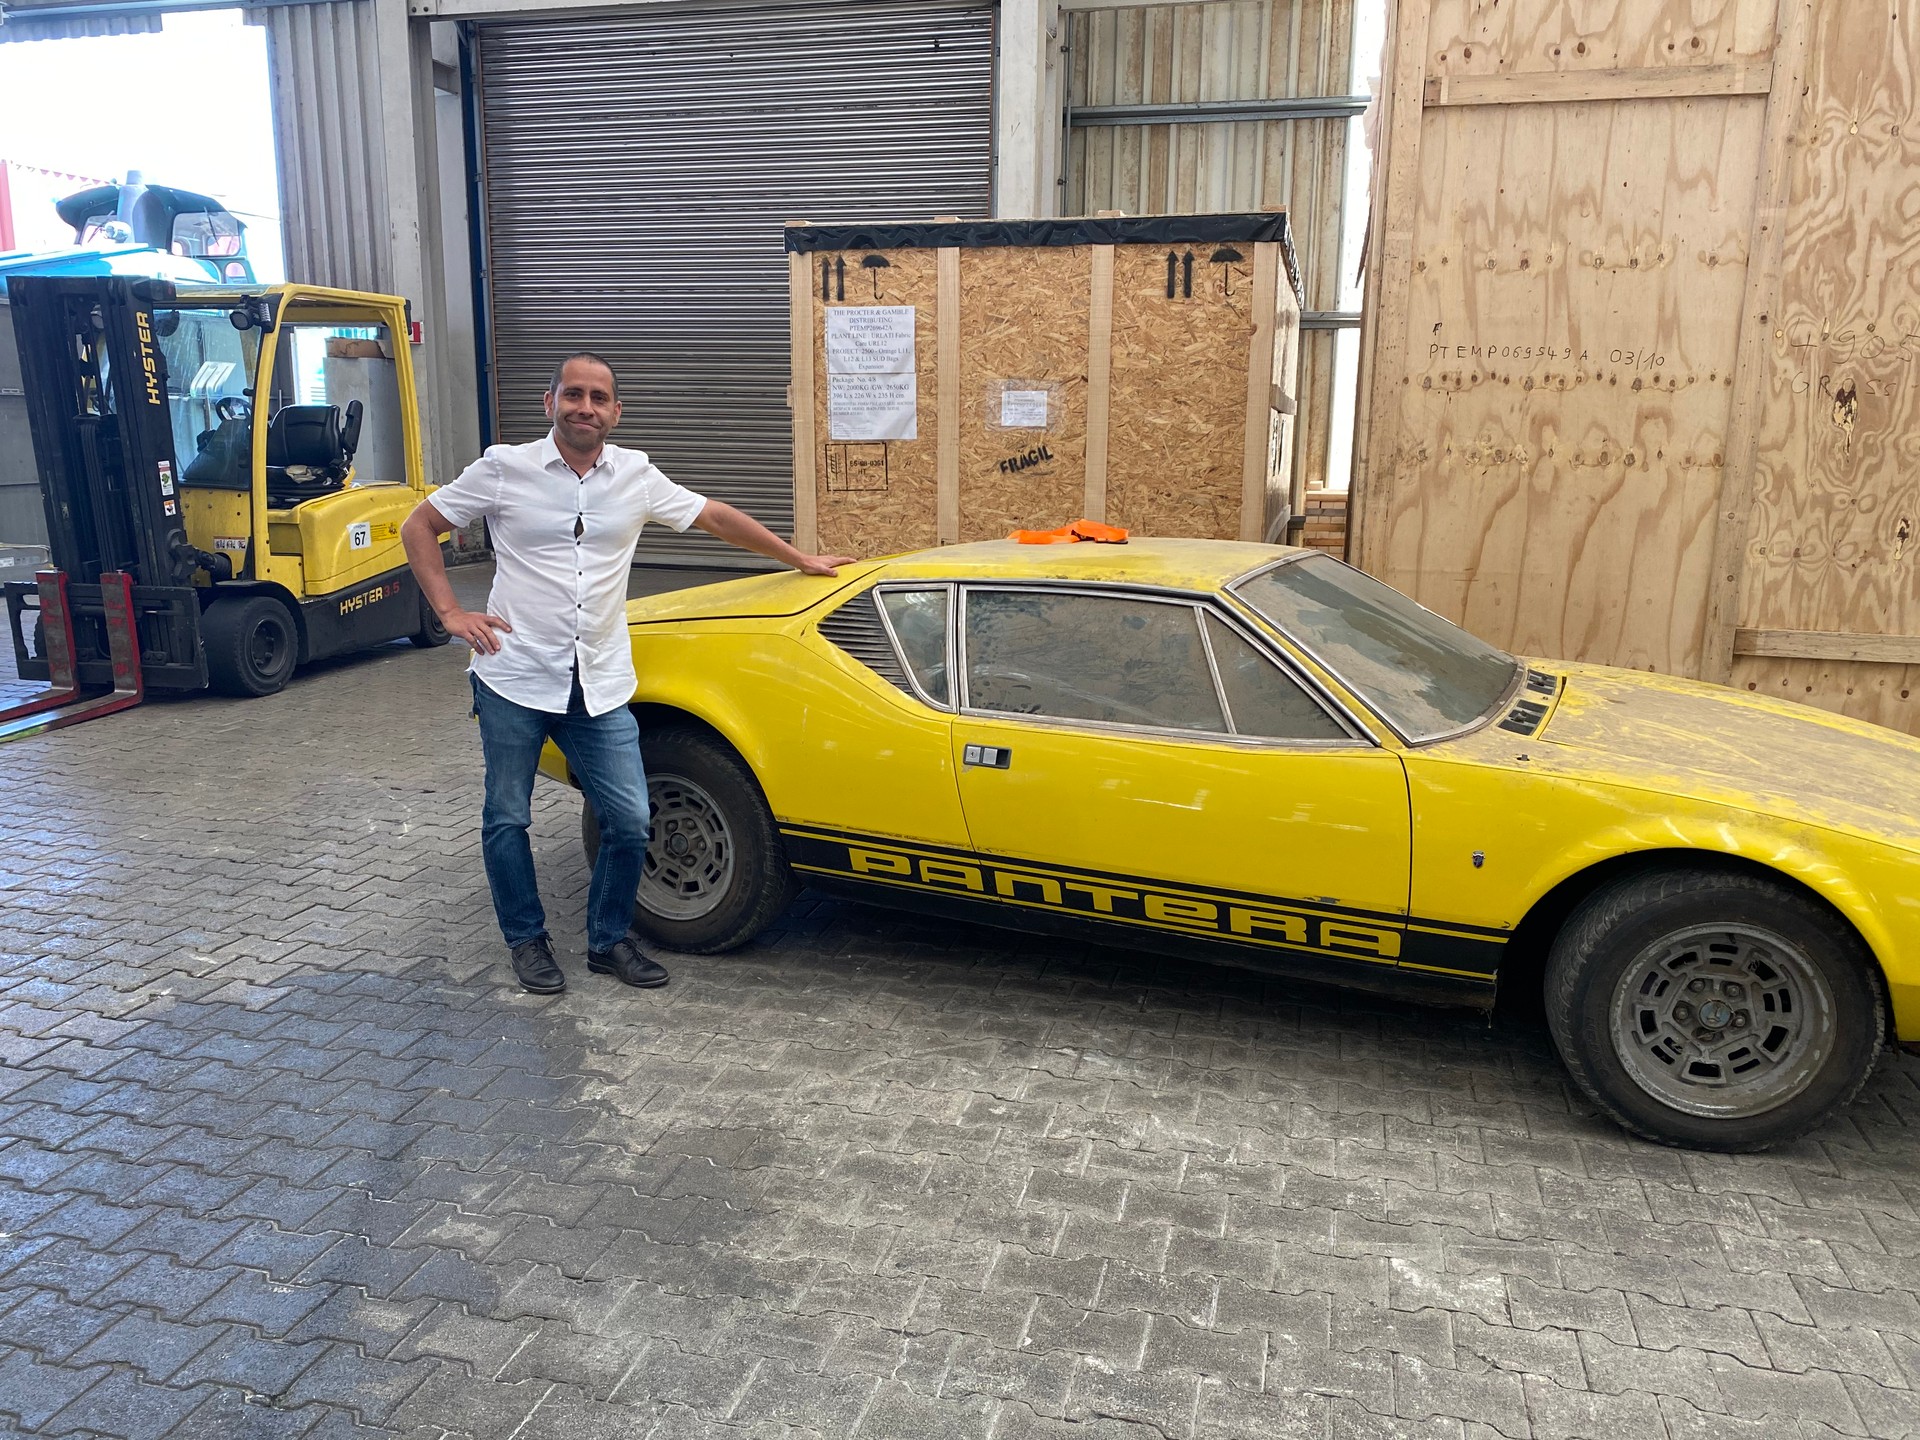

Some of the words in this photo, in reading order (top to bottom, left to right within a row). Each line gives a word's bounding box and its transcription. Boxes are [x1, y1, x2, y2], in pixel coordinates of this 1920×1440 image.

[136, 311, 160, 405] HYSTER
[858, 363, 884, 371] Expansion
[832, 376, 854, 384] Package
[354, 531, 366, 546] 67
[340, 586, 383, 616] HYSTER
